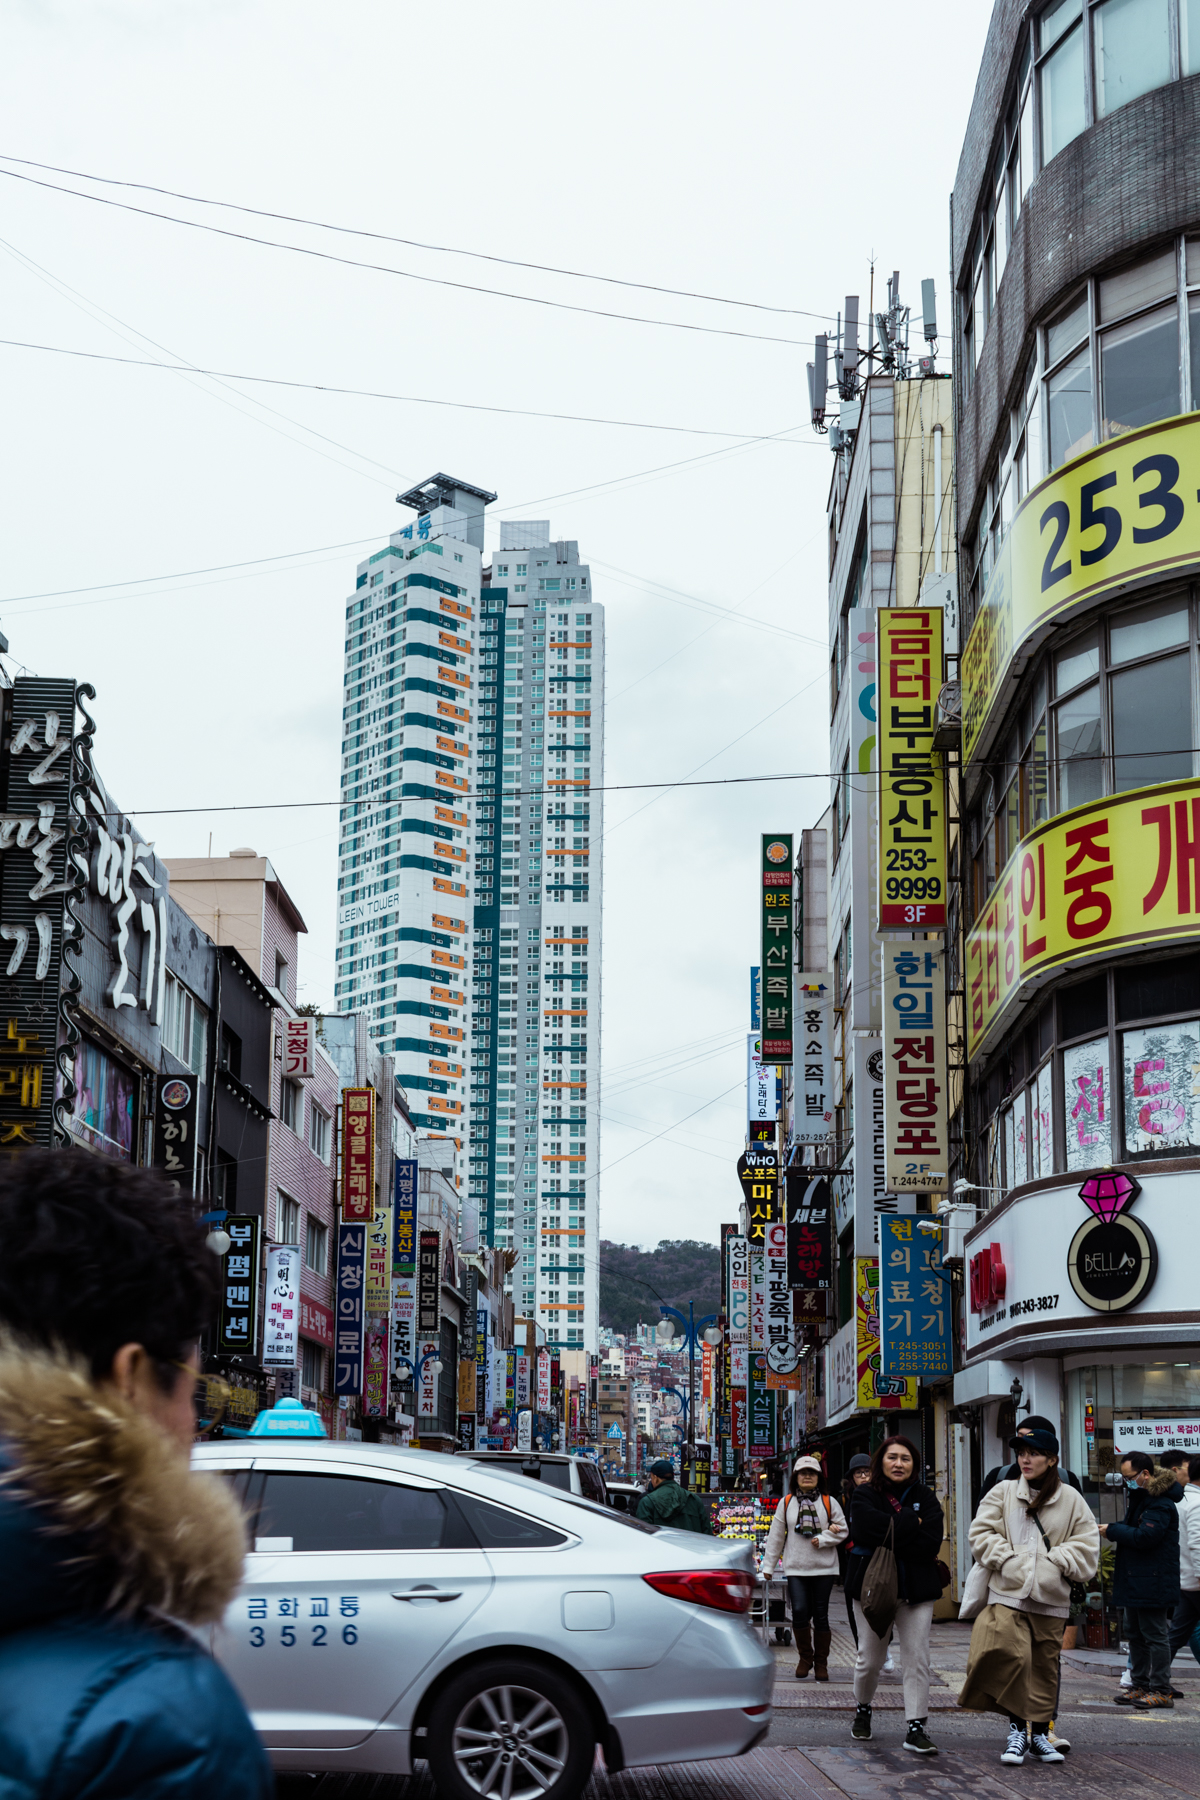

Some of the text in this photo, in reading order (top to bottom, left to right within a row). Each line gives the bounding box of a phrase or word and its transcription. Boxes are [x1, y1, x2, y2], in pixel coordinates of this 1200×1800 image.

[1039, 454, 1200, 594] 253
[888, 612, 933, 701] 금터
[888, 705, 938, 843] 부동산
[886, 848, 937, 872] 253-
[764, 893, 790, 907] 원조
[885, 876, 942, 900] 9999
[367, 893, 400, 914] TOWER
[904, 905, 926, 923] 3F
[766, 915, 789, 1030] 부산족발
[892, 951, 938, 1030] 한일
[287, 1021, 309, 1073] 보청기
[803, 1009, 825, 1116] 홍소족발
[891, 1035, 941, 1155] 전당포
[757, 1130, 768, 1141] 4F
[348, 1115, 369, 1214] 앵콜노래방
[746, 1156, 775, 1166] WHO
[905, 1162, 930, 1175] 2F
[399, 1164, 414, 1207] 지평선
[741, 1168, 777, 1180] 스포츠
[891, 1176, 943, 1186] T.244-4747
[790, 1208, 827, 1224] 세븐
[398, 1210, 414, 1253] 부동산
[421, 1237, 438, 1245] MOTEL
[887, 1218, 943, 1242] 현대
[731, 1241, 748, 1278] 성인
[796, 1226, 824, 1279] 노래방
[1084, 1251, 1136, 1273] BELLA
[369, 1247, 388, 1288] 갈매기
[225, 1224, 251, 1340] 부평맨션
[731, 1279, 748, 1290] 전용
[818, 1279, 829, 1288] B1
[887, 1246, 914, 1337] 의료기
[919, 1249, 944, 1337] 보청기
[337, 1232, 363, 1388] 신창의료기
[732, 1291, 747, 1329] PC
[768, 1259, 791, 1343] 부평족발
[274, 1331, 293, 1341] 요리
[889, 1341, 946, 1351] T.245-3051
[266, 1344, 294, 1354] 전문점
[898, 1352, 947, 1361] 255-3051
[518, 1358, 527, 1374] 고추
[889, 1362, 948, 1371] F.255-7440
[367, 1357, 385, 1405] 노래방
[518, 1376, 527, 1401] 노래방
[753, 1381, 771, 1445] 부산족발
[1118, 1425, 1135, 1436] 집에
[1136, 1425, 1153, 1435] 있는
[1155, 1425, 1175, 1435] 반지,
[1148, 1438, 1165, 1447] 리폼
[246, 1595, 361, 1620] 금화교통
[249, 1623, 360, 1648] 3526
